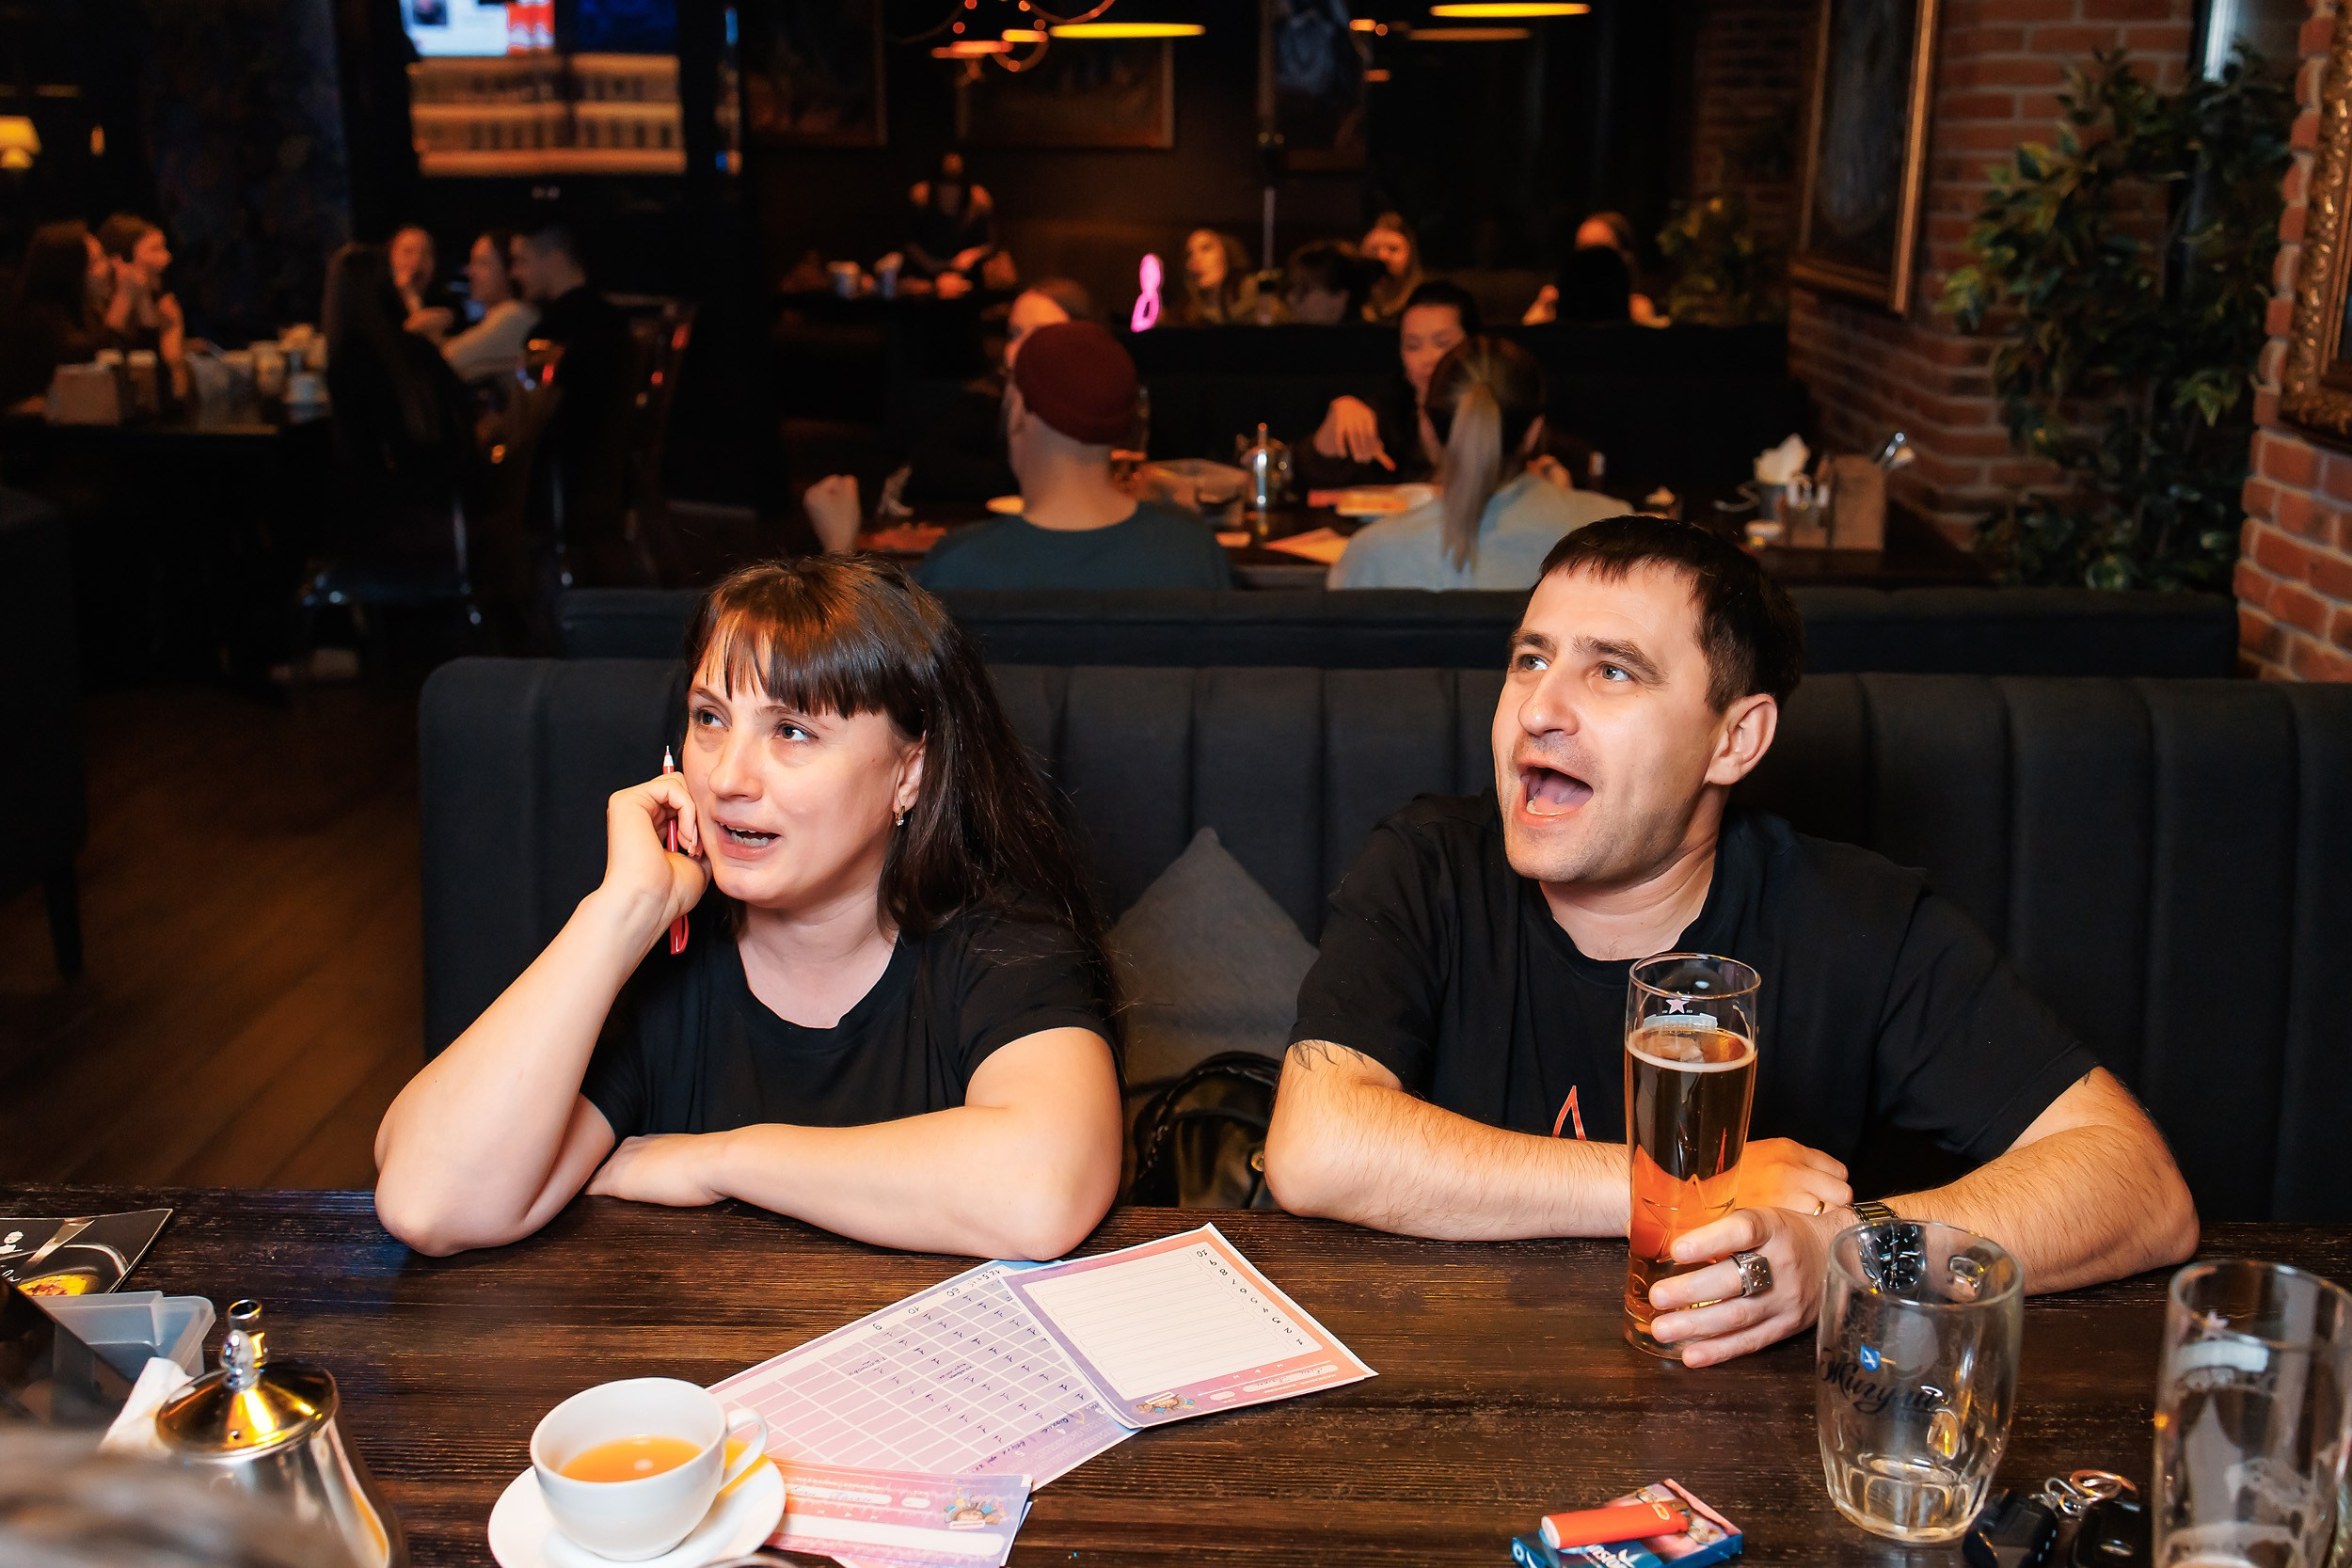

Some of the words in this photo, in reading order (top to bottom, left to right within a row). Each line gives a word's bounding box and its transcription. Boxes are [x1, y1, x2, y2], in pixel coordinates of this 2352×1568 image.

[1196, 1248, 1208, 1258] 10
[1219, 1268, 1229, 1276] 8
[908, 1306, 920, 1314] 10
